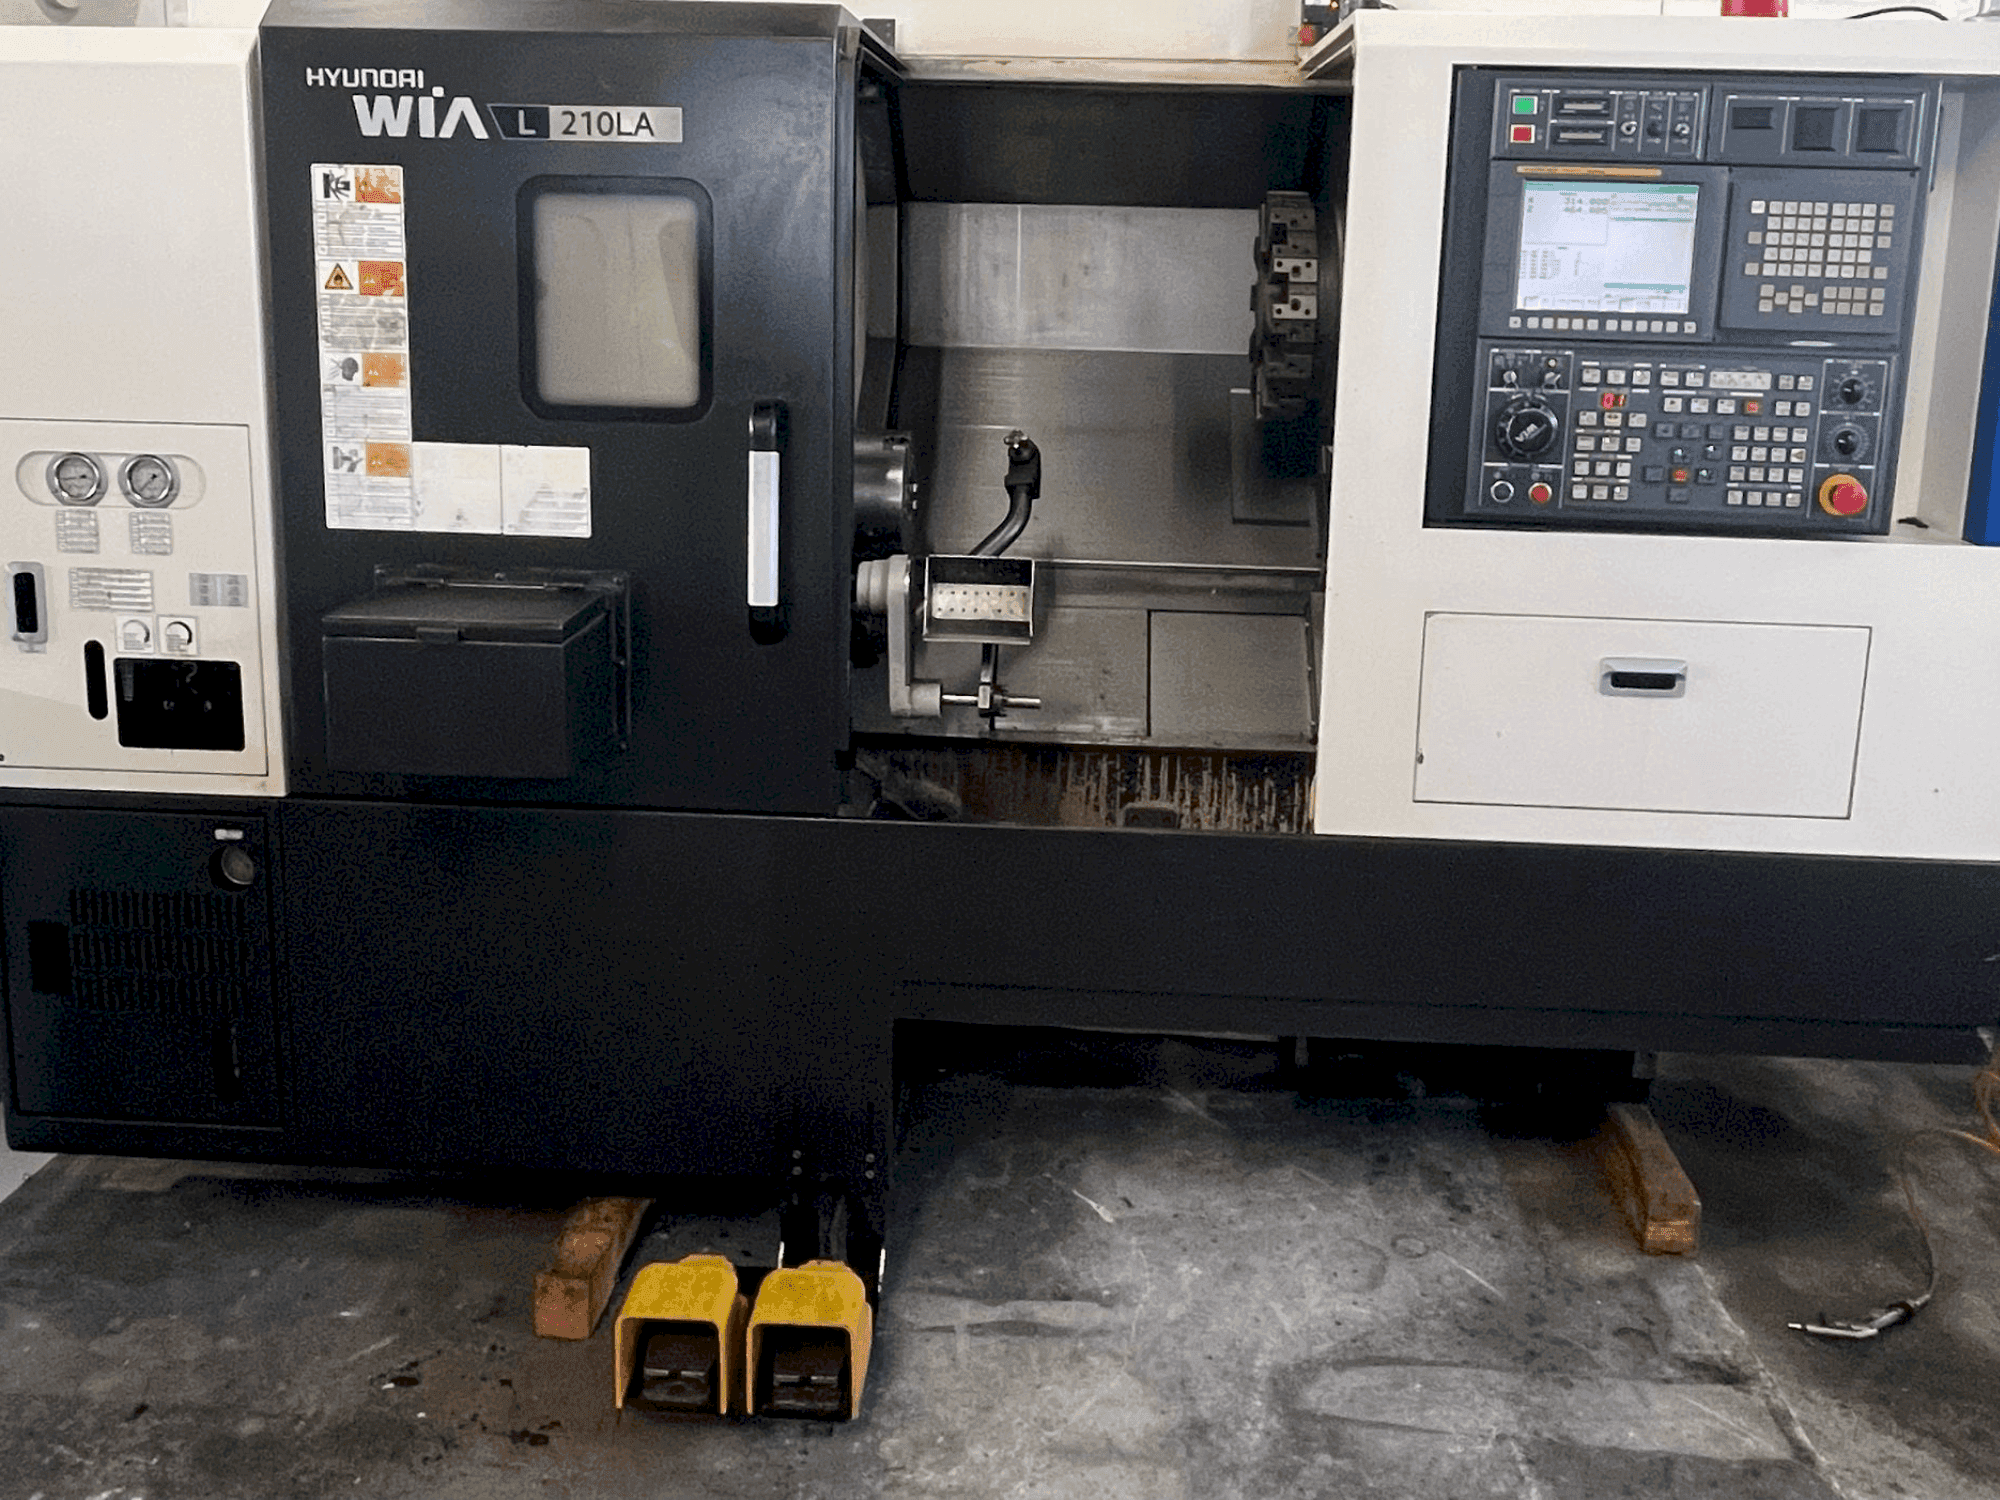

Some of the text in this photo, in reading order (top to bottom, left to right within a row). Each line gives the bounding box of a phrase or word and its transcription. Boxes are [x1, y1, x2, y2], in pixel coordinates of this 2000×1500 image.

[305, 67, 425, 89] HYUNDAI
[518, 109, 655, 137] L 210LA
